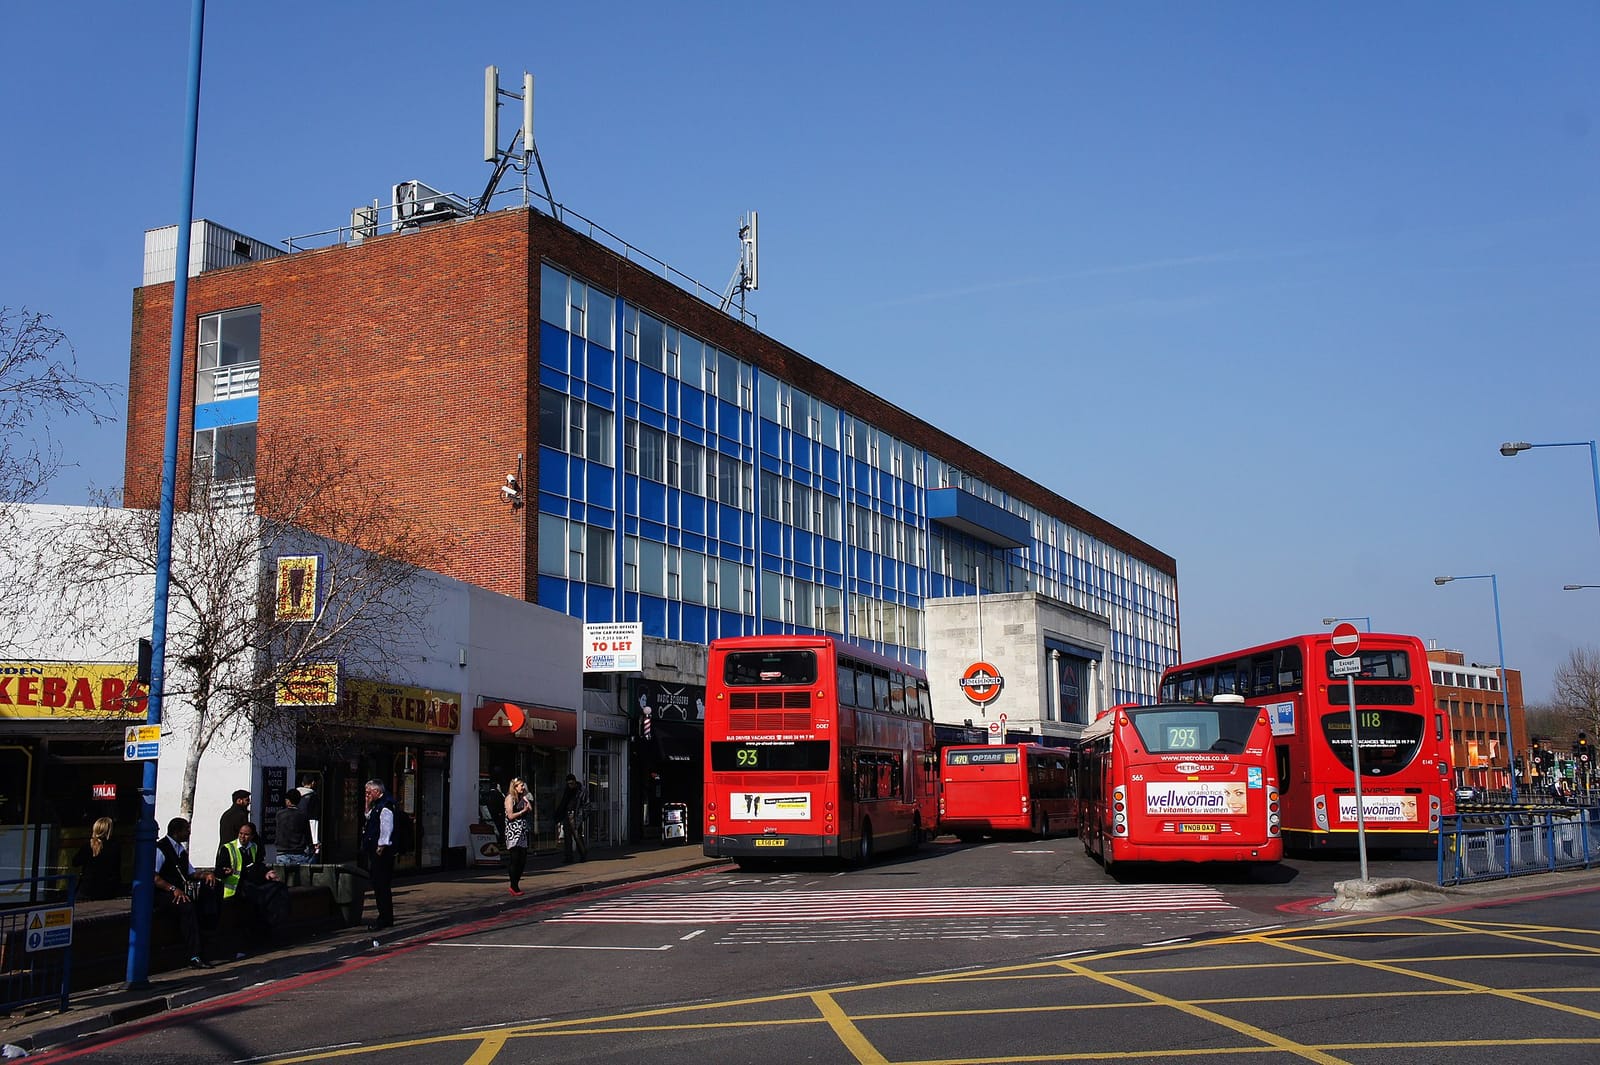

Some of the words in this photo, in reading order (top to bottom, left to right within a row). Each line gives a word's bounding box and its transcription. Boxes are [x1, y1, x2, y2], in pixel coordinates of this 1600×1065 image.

[592, 642, 608, 652] TO
[612, 641, 632, 651] LET
[657, 694, 670, 704] MAGIC
[670, 695, 689, 705] SCISSORS
[391, 695, 459, 730] KEBABS
[1361, 713, 1381, 728] 118
[1169, 728, 1196, 748] 293
[737, 749, 758, 766] 93
[954, 755, 968, 764] 470
[93, 787, 116, 797] HALAL
[1147, 790, 1224, 807] wellwoman
[1341, 806, 1401, 815] wewoman
